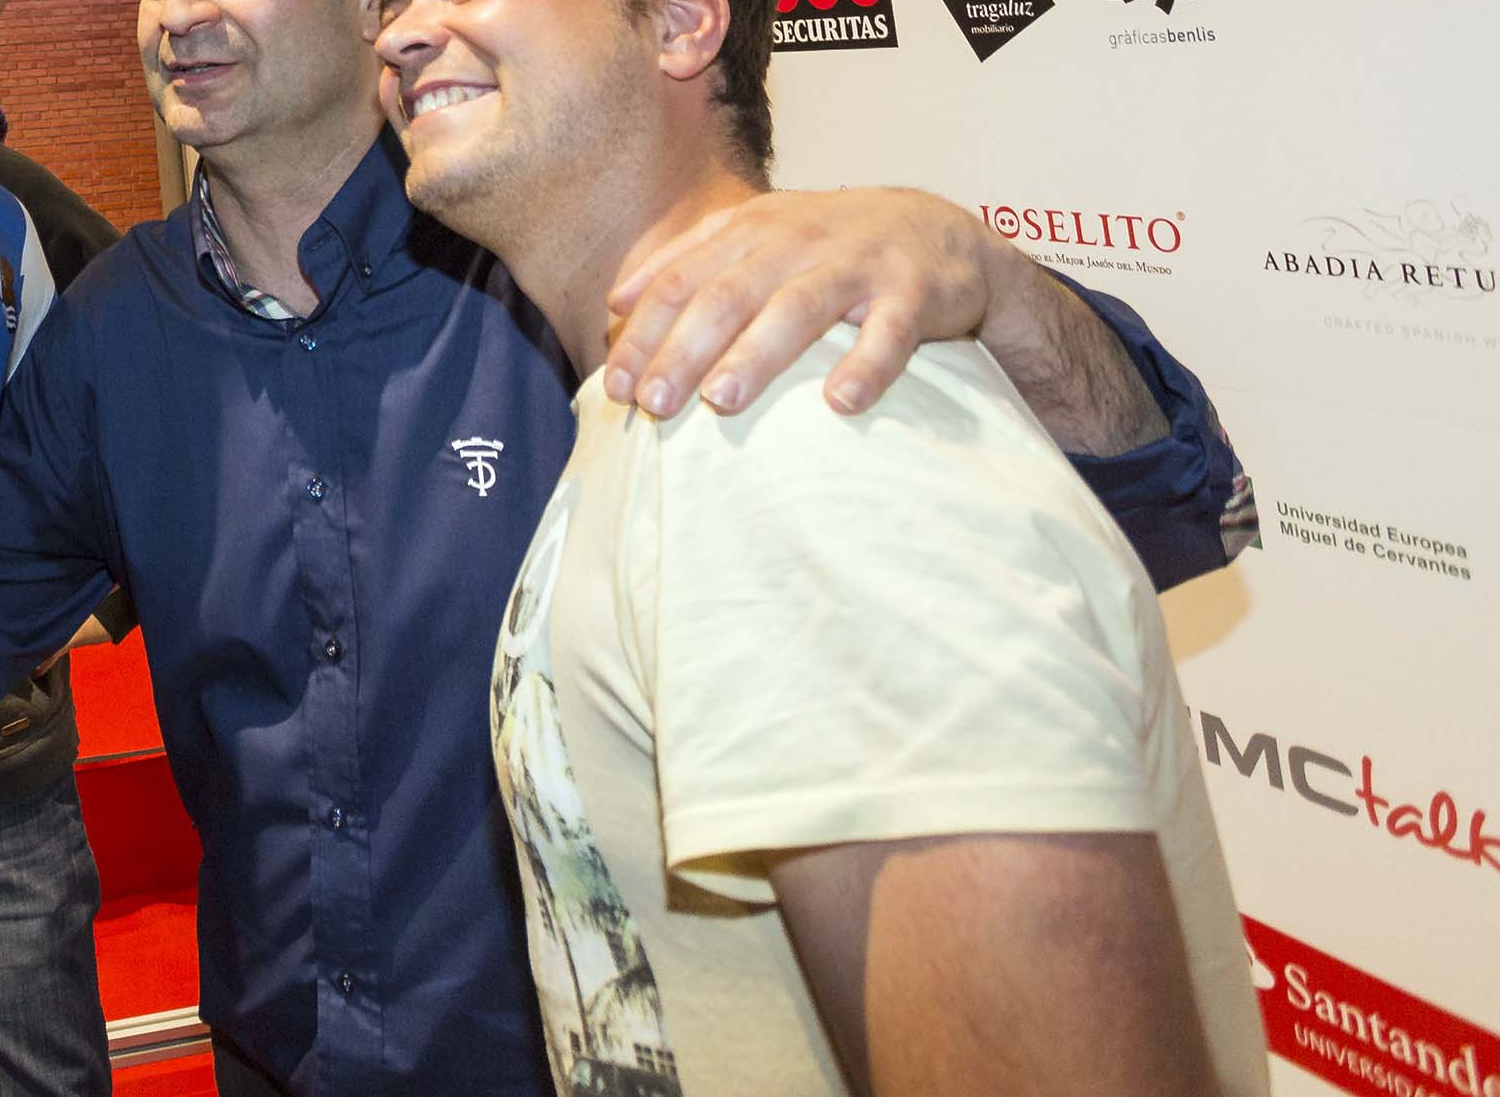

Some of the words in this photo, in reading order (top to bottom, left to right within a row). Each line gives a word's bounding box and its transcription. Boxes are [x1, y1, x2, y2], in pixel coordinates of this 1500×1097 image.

[773, 14, 889, 44] SECURITAS
[971, 24, 1015, 35] mobiliario
[1263, 250, 1384, 281] ABADIA
[1400, 263, 1496, 292] RETU
[1276, 501, 1381, 538] Universidad
[1386, 526, 1468, 559] Europea
[1279, 520, 1338, 547] Miguel
[1344, 537, 1366, 554] de
[1373, 542, 1472, 581] Cervantes
[1294, 1022, 1438, 1097] UNIVERSID
